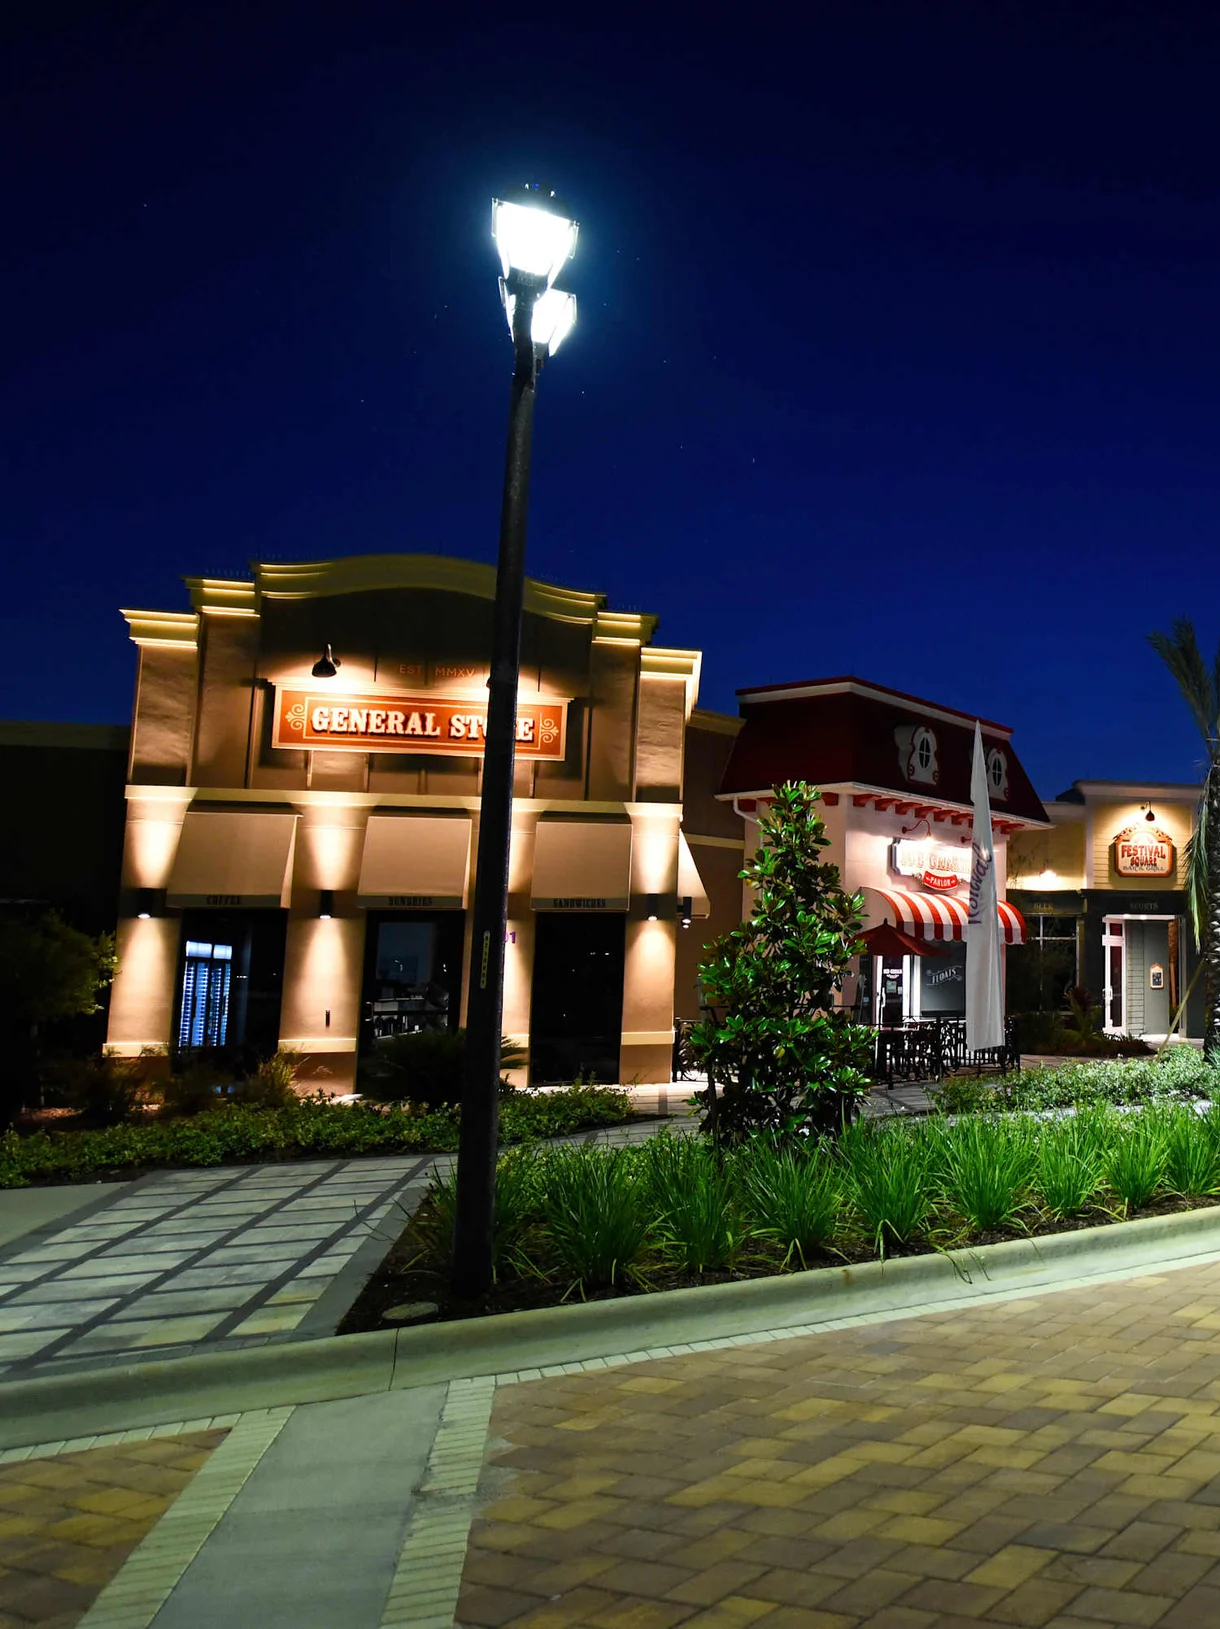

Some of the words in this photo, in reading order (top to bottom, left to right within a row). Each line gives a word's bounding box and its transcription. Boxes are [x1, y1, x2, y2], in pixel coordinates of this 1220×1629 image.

[435, 665, 475, 677] MMXV
[310, 706, 441, 737] GENERAL
[450, 712, 535, 742] STE
[1121, 844, 1166, 859] FESTIVAL
[1130, 856, 1157, 867] SQUARE
[930, 876, 951, 887] PARLOR
